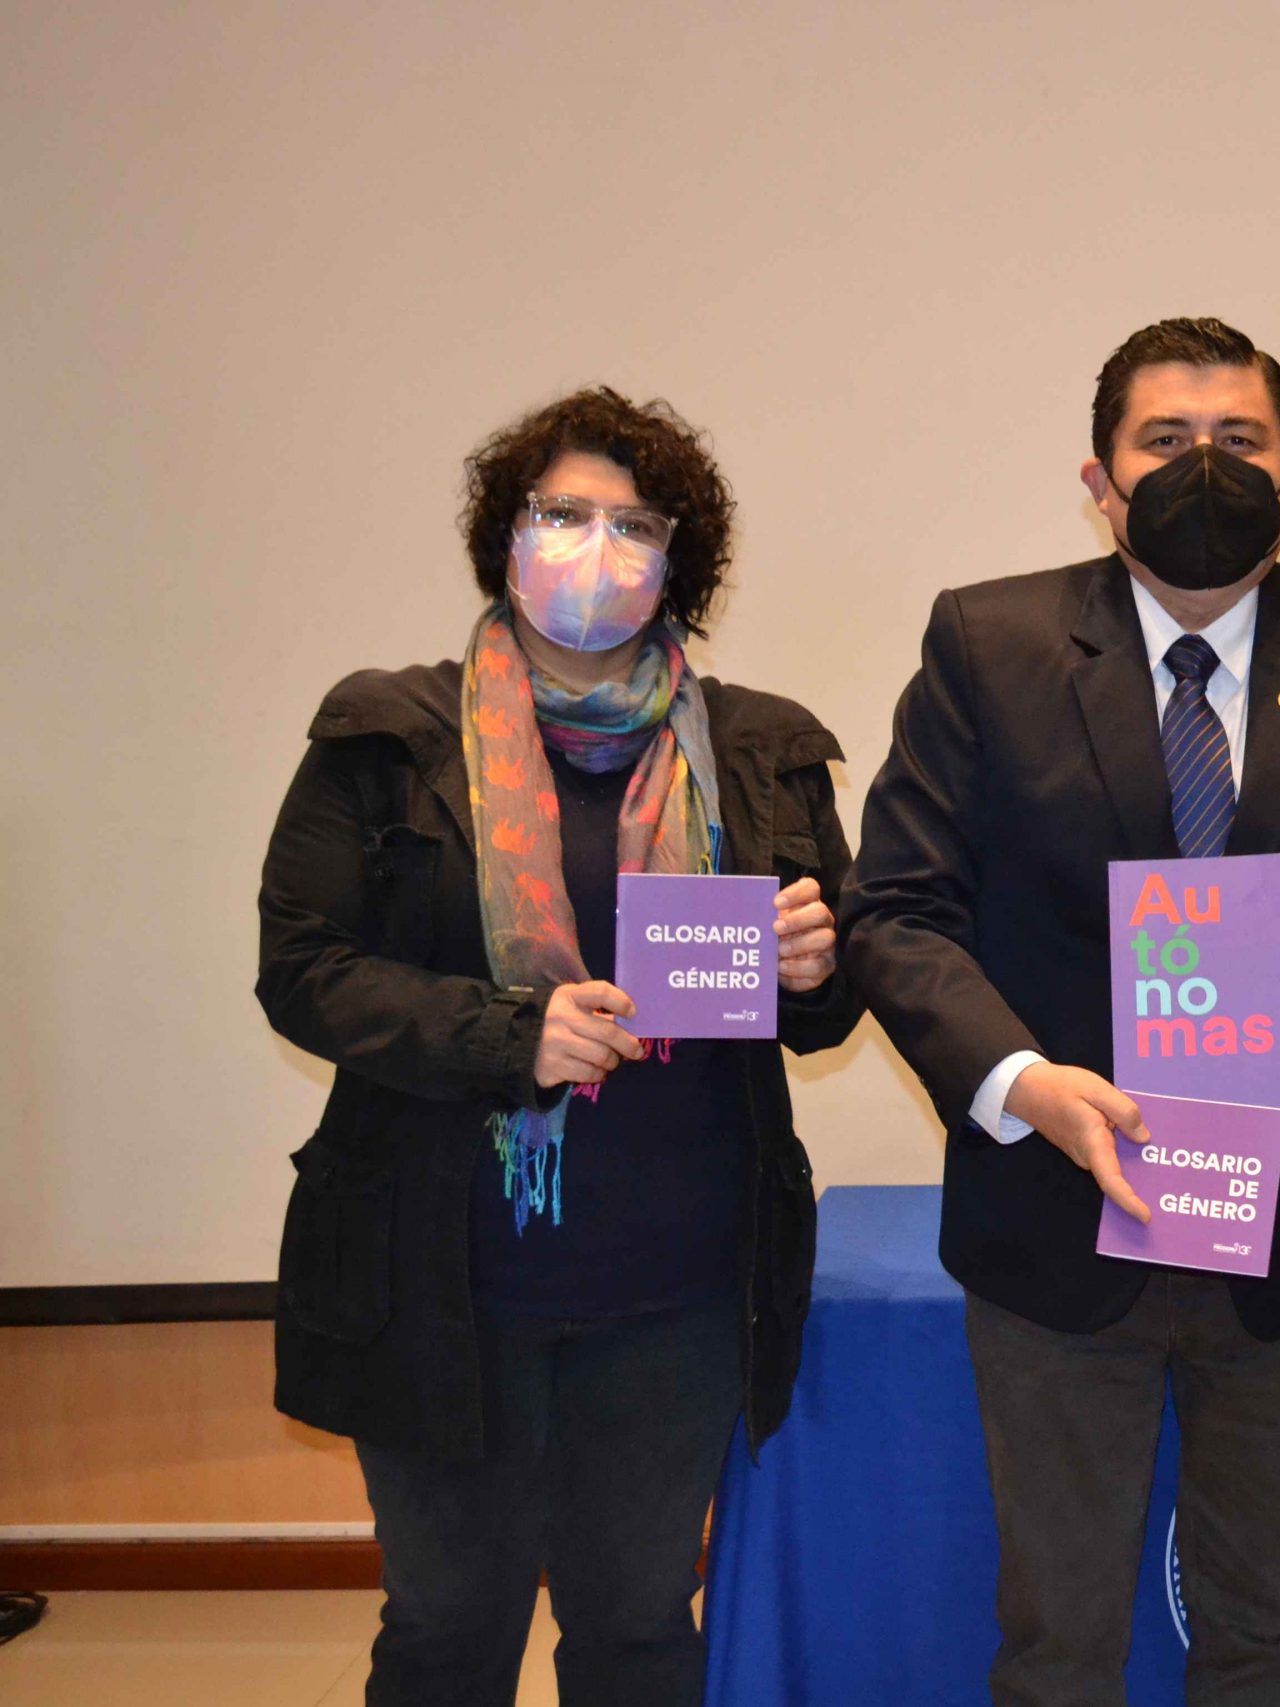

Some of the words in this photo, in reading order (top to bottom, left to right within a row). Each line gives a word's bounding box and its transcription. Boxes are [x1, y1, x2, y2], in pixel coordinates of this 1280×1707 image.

[1129, 871, 1221, 926] Au
[645, 924, 761, 944] GLOSARIO
[732, 948, 760, 967] DE
[1130, 924, 1200, 976] tó
[668, 967, 760, 989] GÉNERO
[1135, 977, 1218, 1016] no
[1136, 1013, 1275, 1058] mas
[1141, 1144, 1262, 1176] GLOSARIO
[1228, 1178, 1260, 1200] DE
[1159, 1192, 1257, 1223] GÉNERO
